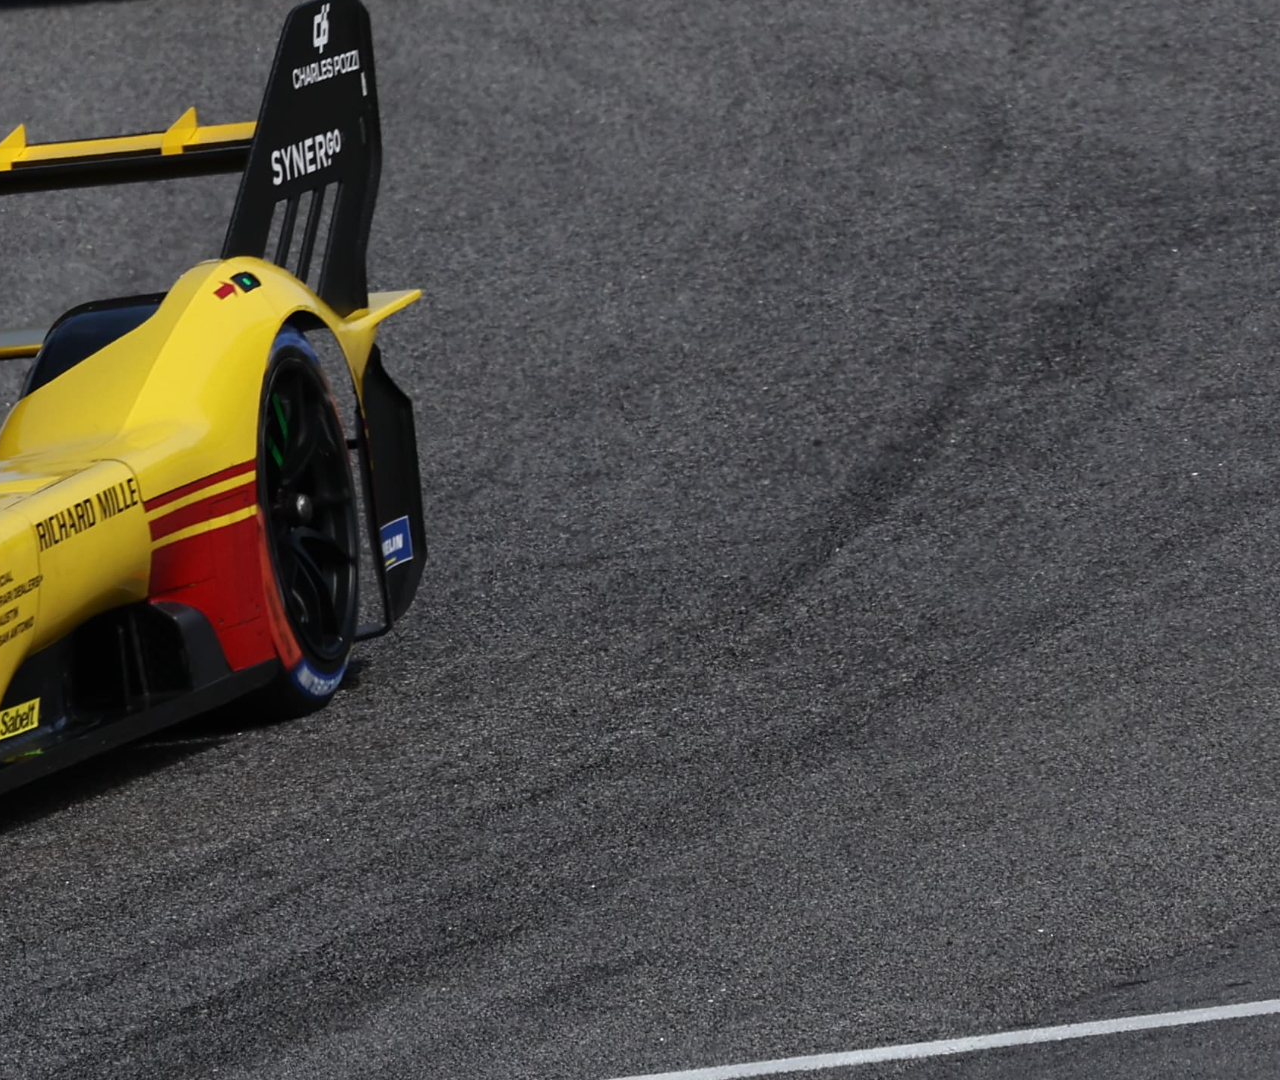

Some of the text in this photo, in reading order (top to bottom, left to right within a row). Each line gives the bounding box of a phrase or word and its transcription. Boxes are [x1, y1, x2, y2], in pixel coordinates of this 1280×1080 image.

[292, 49, 361, 90] CHARLES POZZI
[35, 477, 139, 553] RICHARD MILLE
